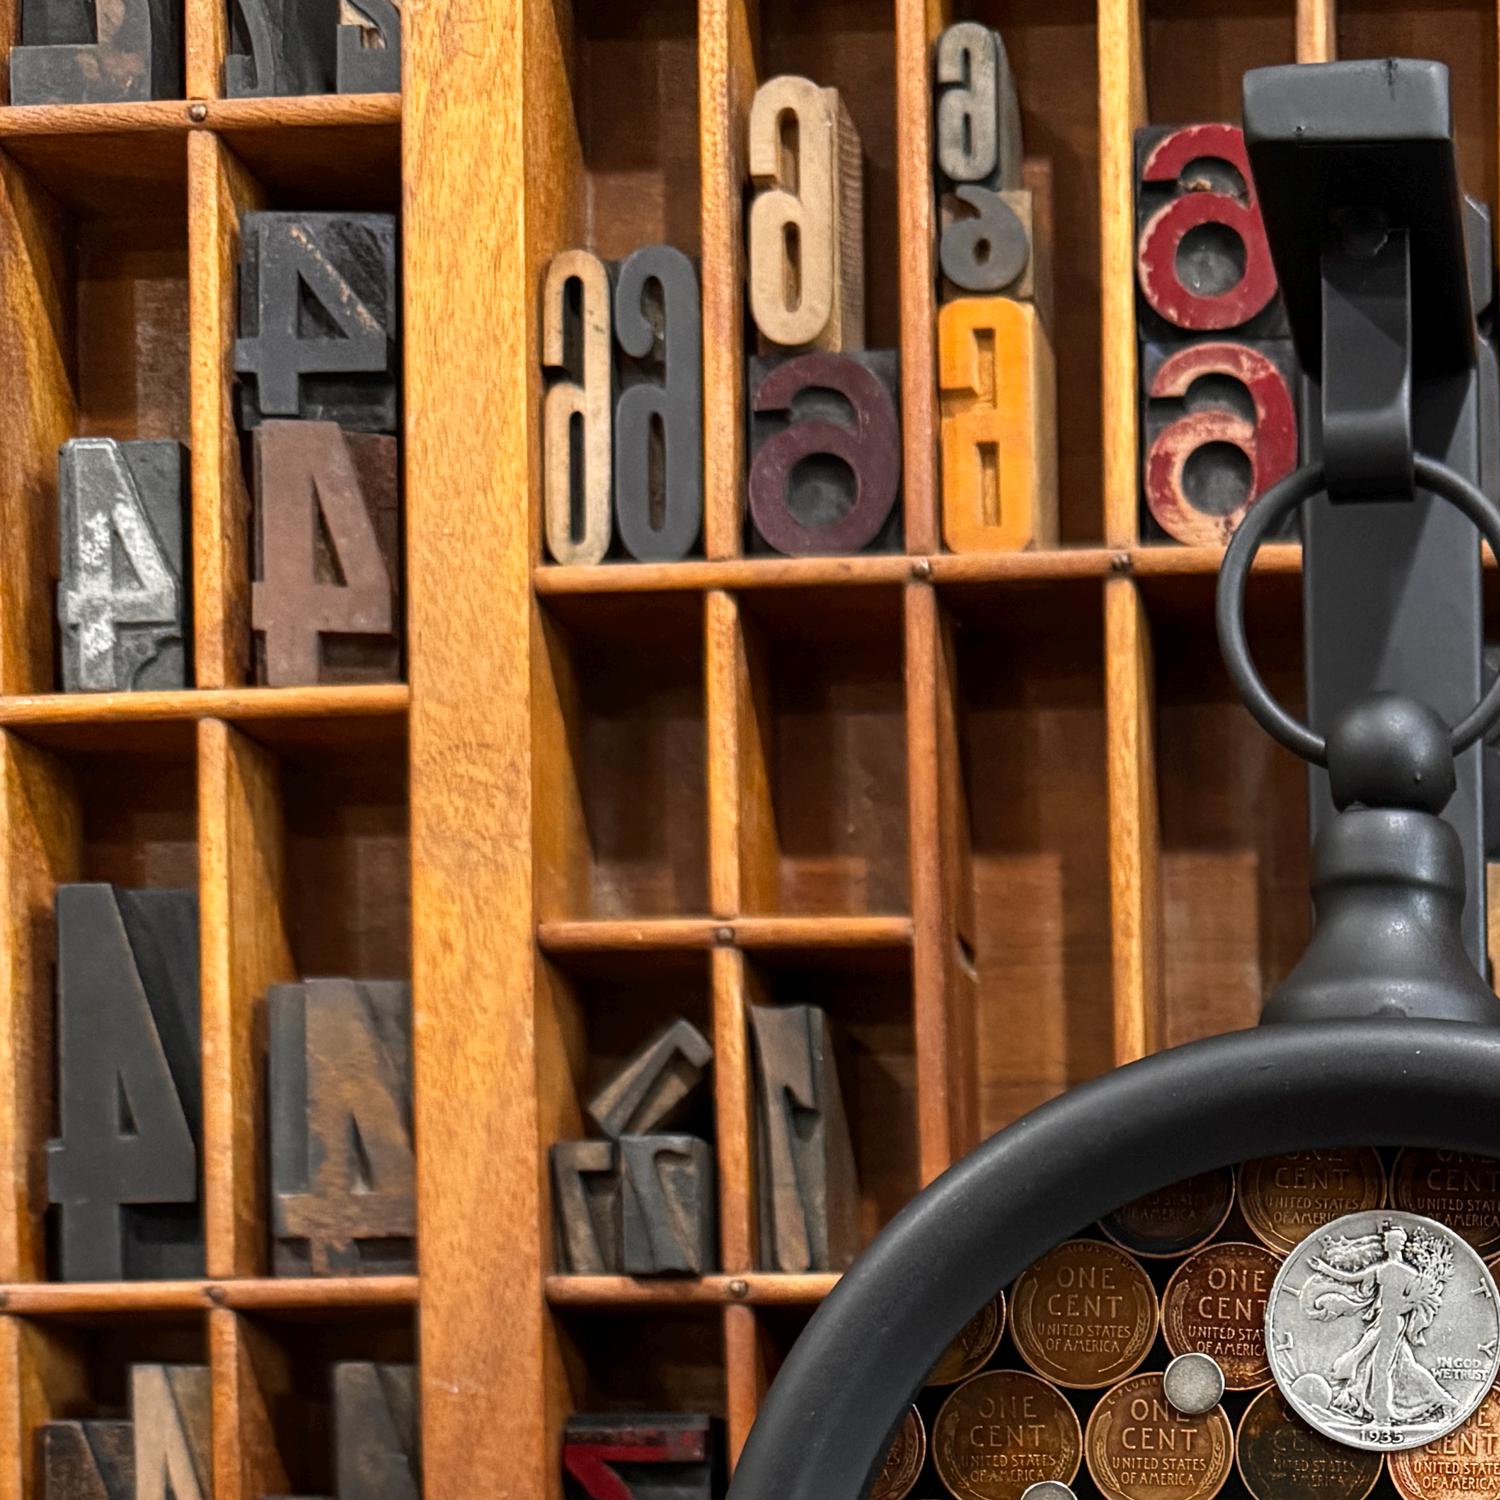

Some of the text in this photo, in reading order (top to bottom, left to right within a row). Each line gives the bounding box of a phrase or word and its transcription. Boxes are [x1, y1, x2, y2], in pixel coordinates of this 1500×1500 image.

[1274, 1167, 1350, 1191] CENT
[1056, 1265, 1115, 1289] ONE
[1207, 1268, 1266, 1292] ONE
[1047, 1294, 1123, 1318] CENT
[1037, 1323, 1131, 1337] UNITED STATES
[1453, 1369, 1490, 1381] TRUST
[1455, 1358, 1482, 1369] GOD
[979, 1395, 1038, 1419] ONE
[970, 1424, 1046, 1448] CENT
[1121, 1427, 1197, 1451] CENT
[1111, 1456, 1205, 1470] UNITED STATES
[1138, 1471, 1194, 1485] AMERICA
